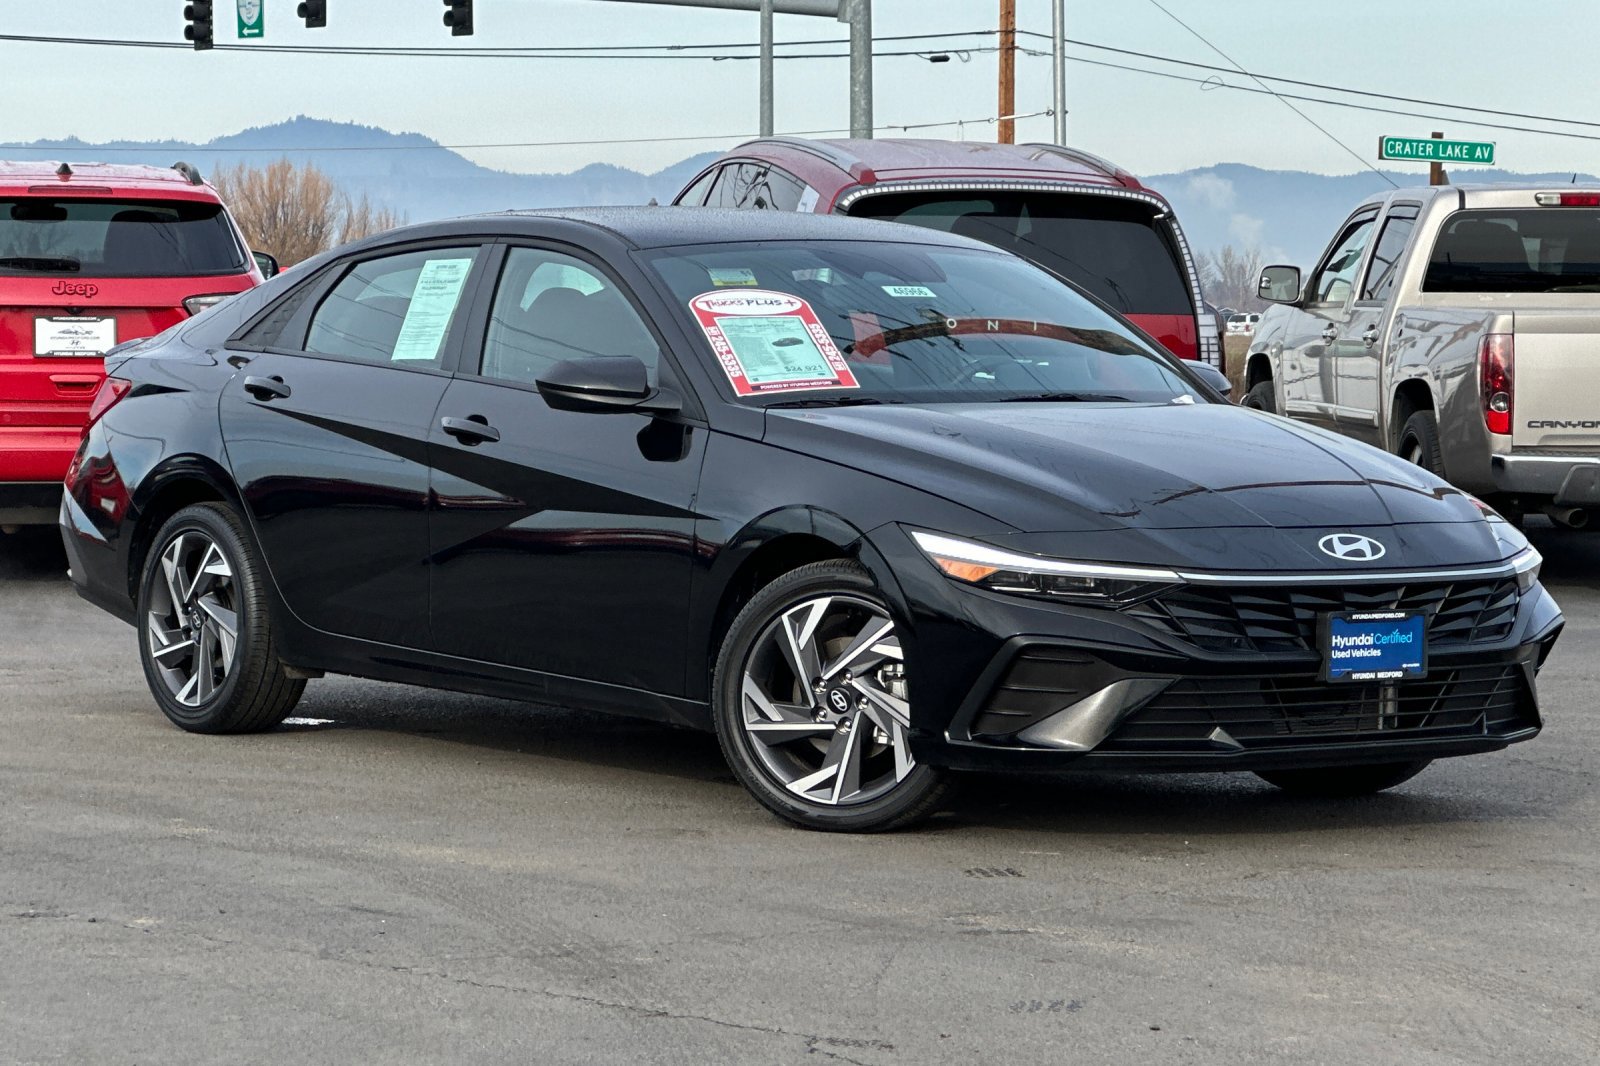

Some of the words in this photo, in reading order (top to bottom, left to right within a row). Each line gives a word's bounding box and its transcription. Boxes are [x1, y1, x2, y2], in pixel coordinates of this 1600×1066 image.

[1387, 141, 1433, 156] CRATER
[1439, 144, 1469, 159] LAKE
[1475, 146, 1491, 159] AV
[52, 281, 98, 298] Jeep
[1331, 633, 1374, 649] Hyundai
[1374, 630, 1413, 645] Certified
[1331, 649, 1351, 659] Used
[1351, 647, 1382, 658] Vehicles
[1352, 672, 1376, 680] HYUNDAI
[1377, 671, 1404, 679] MEDFORD
